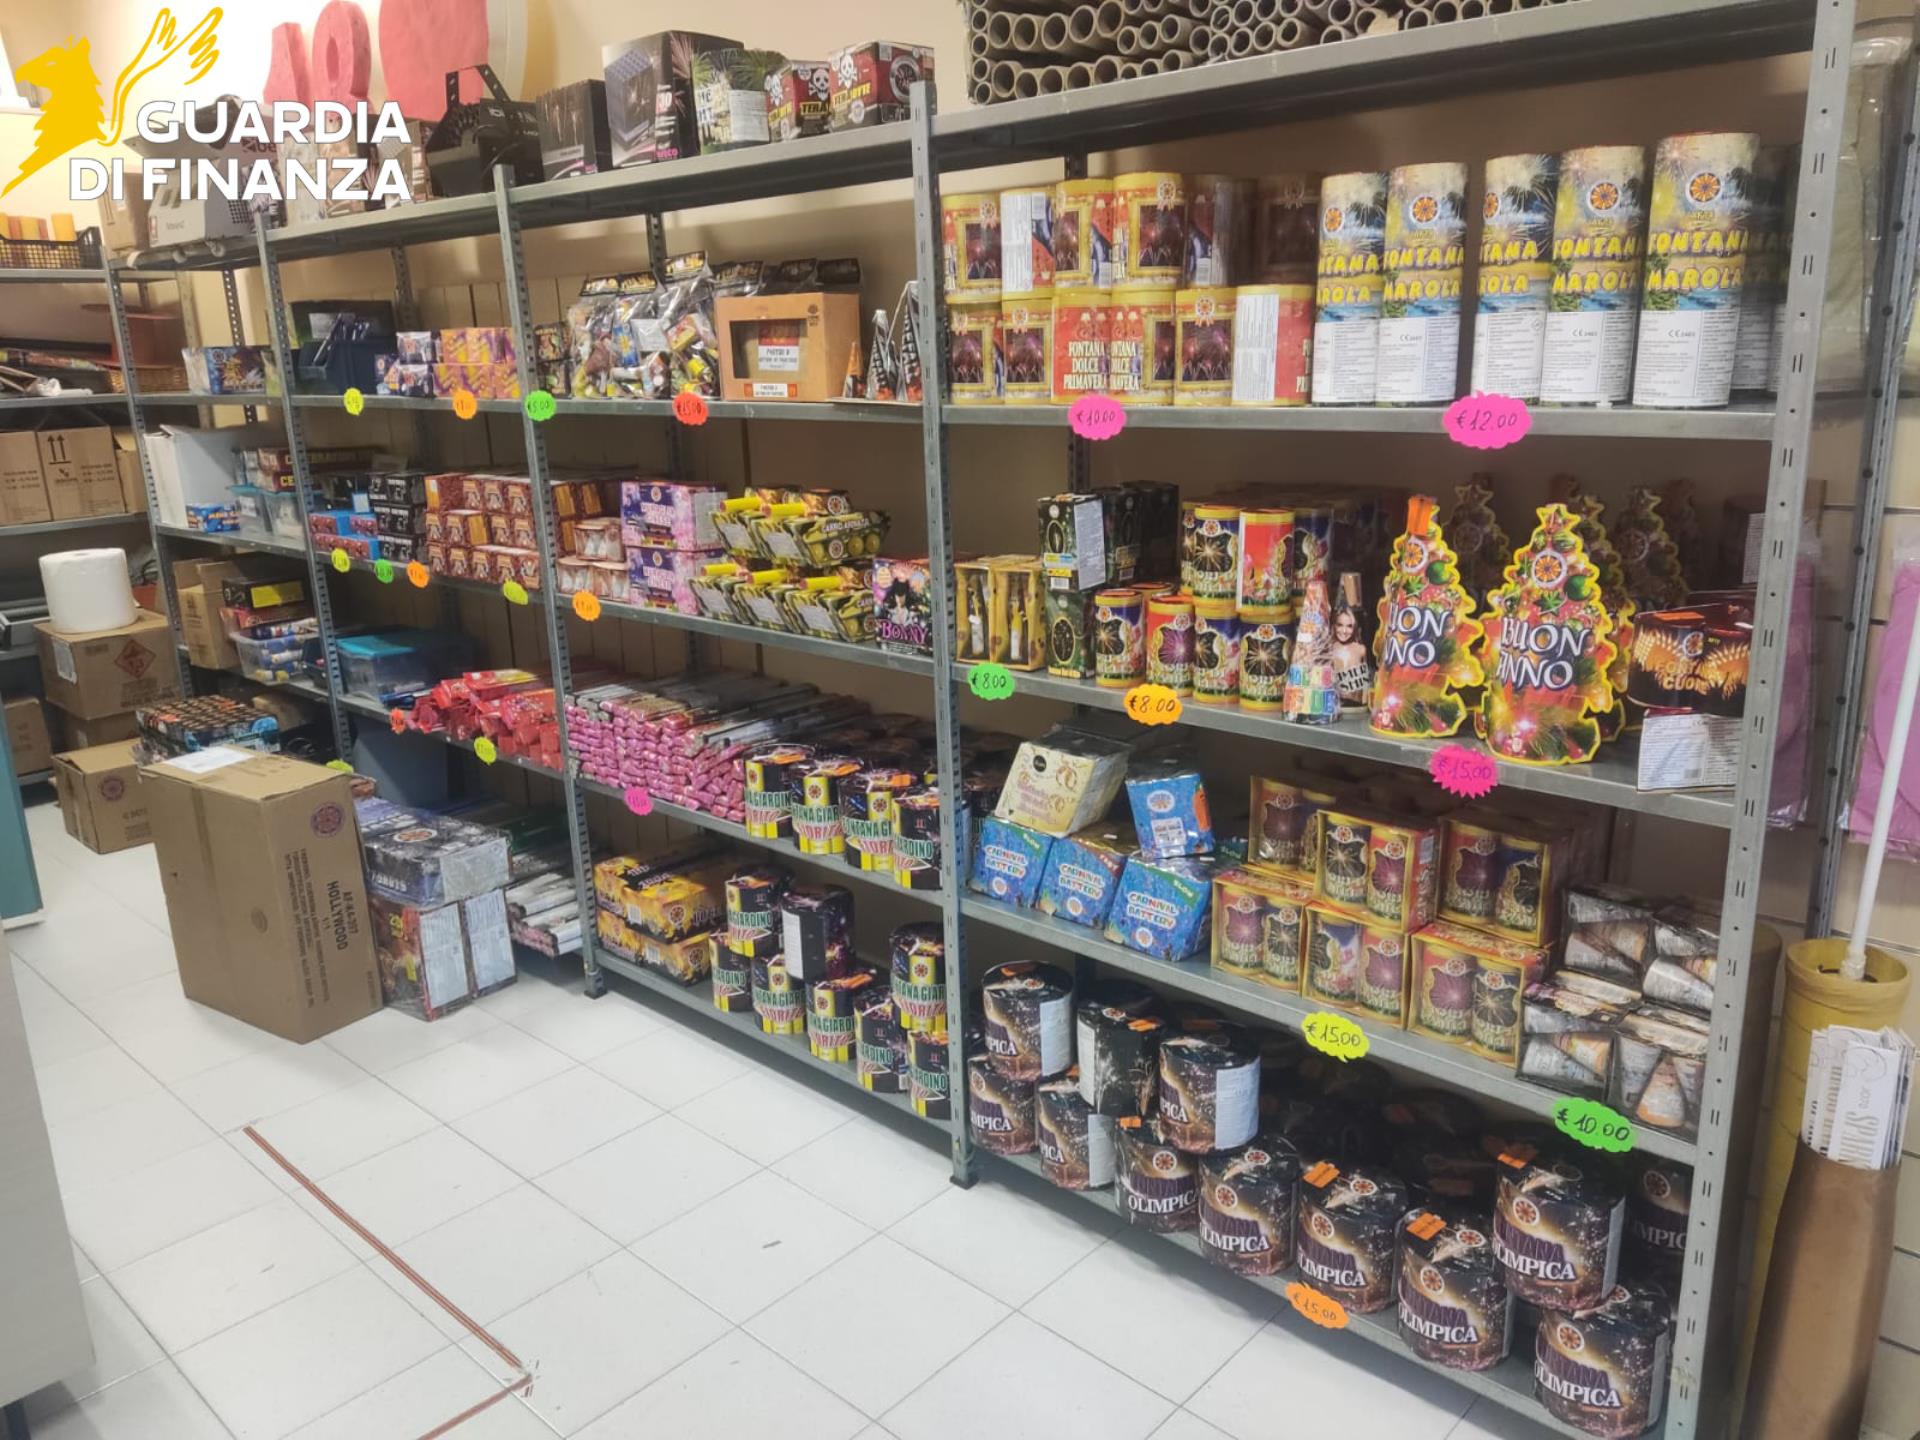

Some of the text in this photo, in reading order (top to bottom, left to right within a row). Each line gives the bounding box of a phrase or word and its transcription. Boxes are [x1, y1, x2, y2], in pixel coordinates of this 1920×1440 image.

[882, 621, 928, 645] BONNY
[1501, 617, 1591, 657] BUON
[1495, 650, 1574, 690] ANNO
[326, 880, 349, 951] HOLLYWOOD
[1127, 891, 1180, 916] CARNIVAL
[1127, 903, 1177, 930] BATTERY
